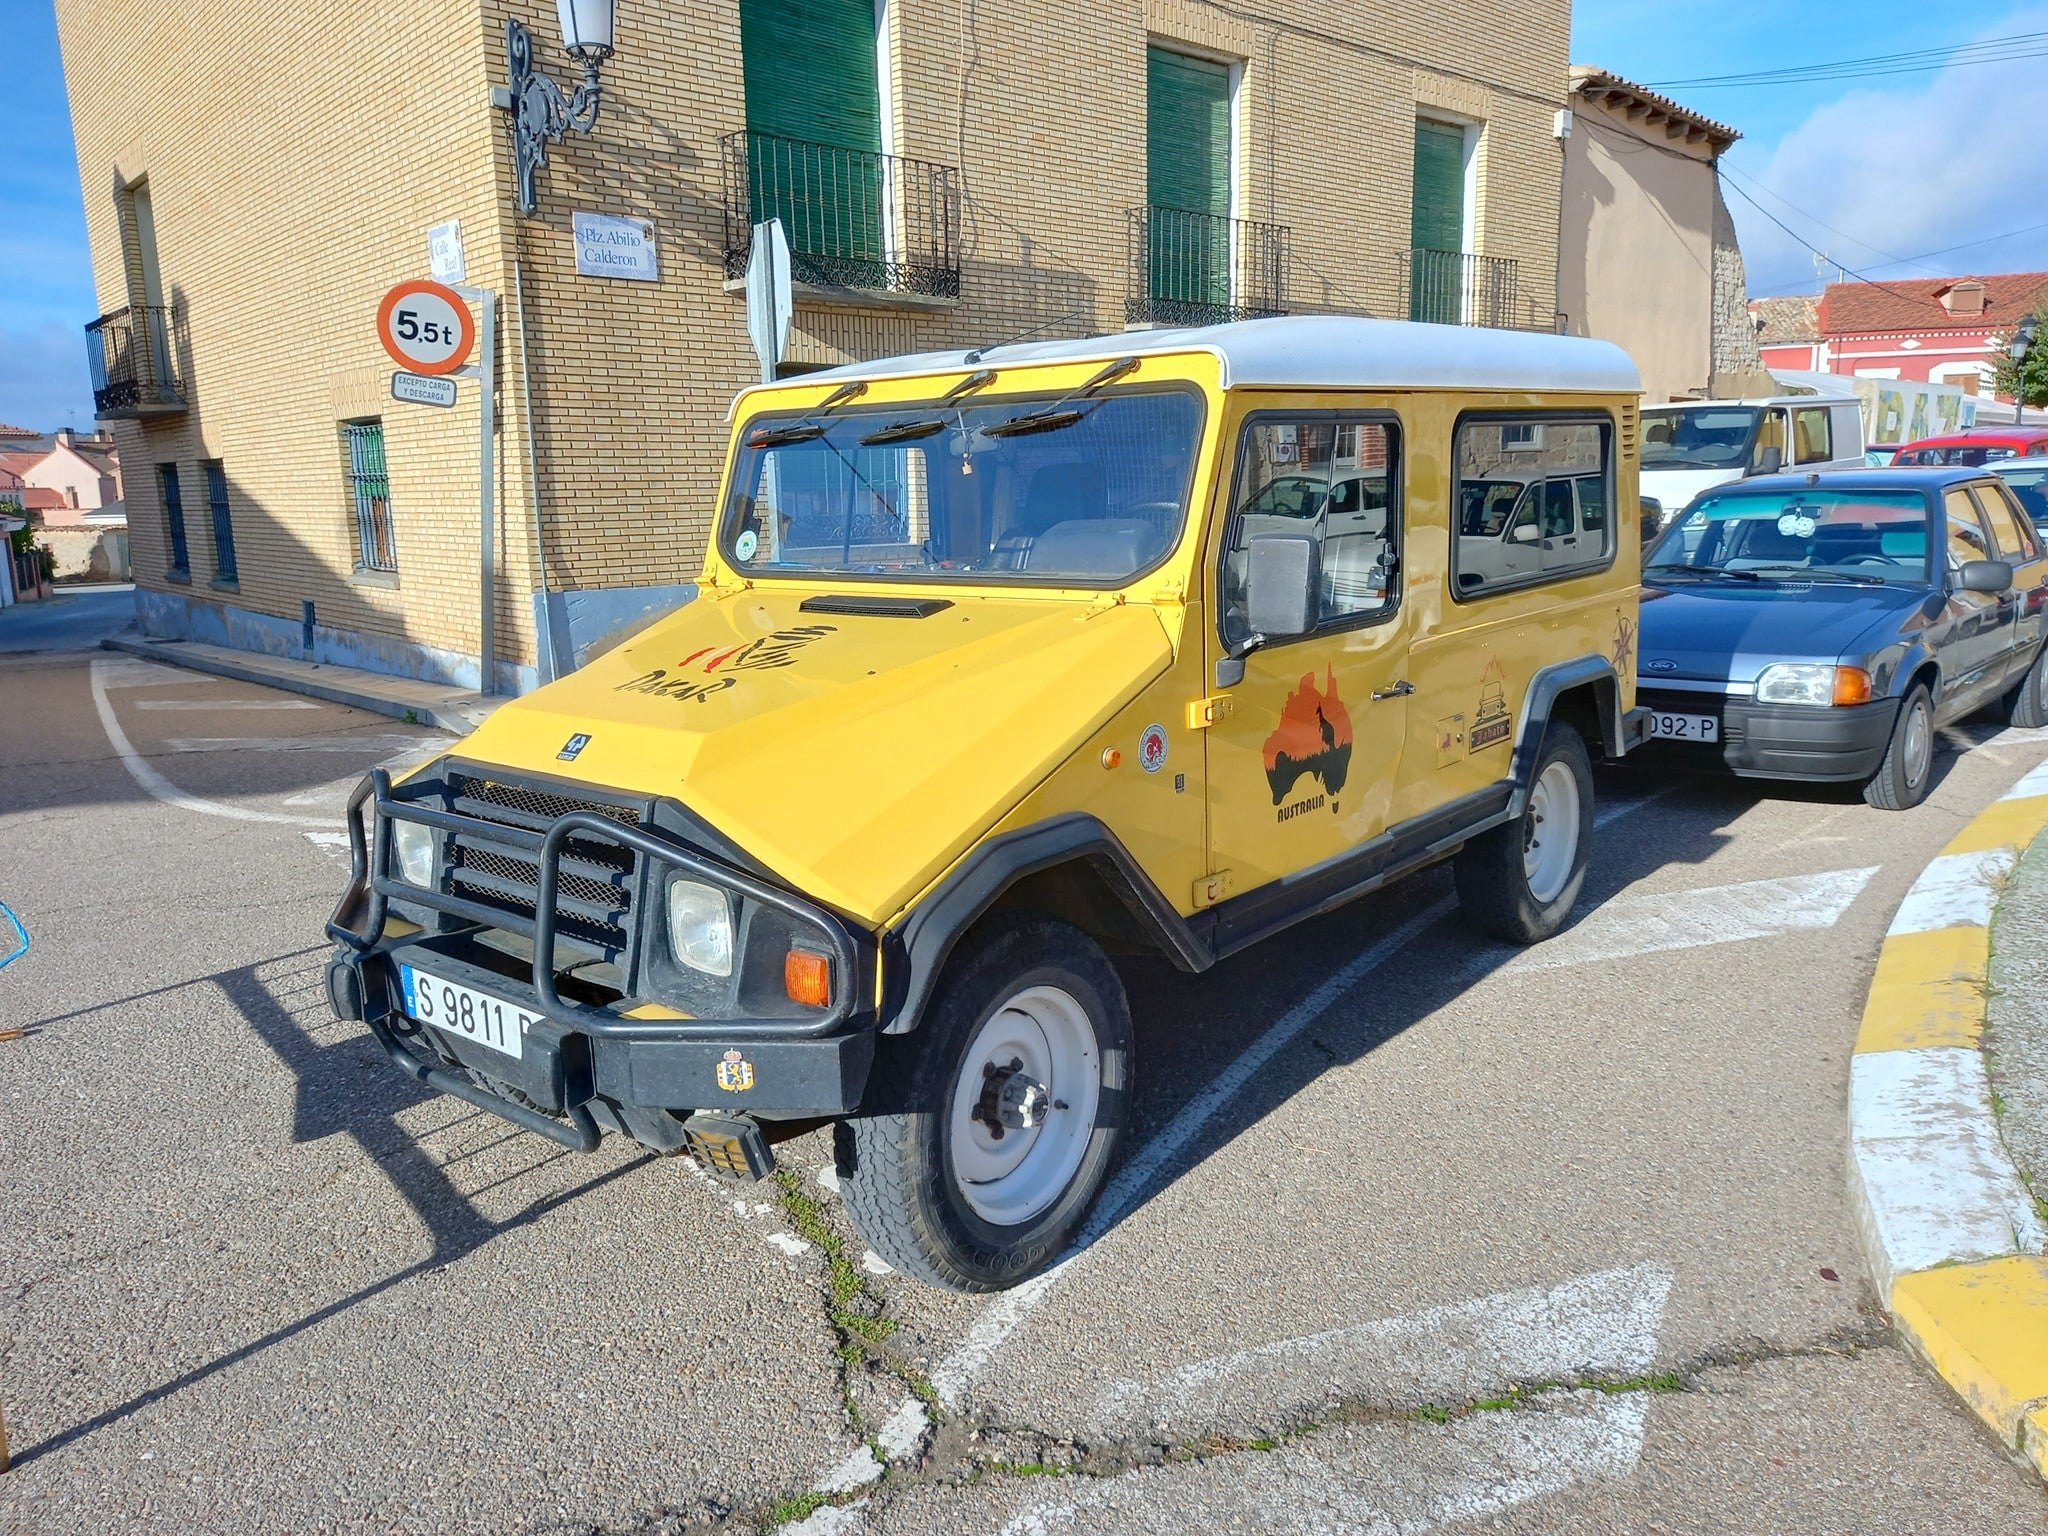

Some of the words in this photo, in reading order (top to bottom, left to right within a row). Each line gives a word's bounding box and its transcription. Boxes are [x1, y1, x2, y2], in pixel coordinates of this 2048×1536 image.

[607, 231, 641, 247] Abilio
[584, 248, 638, 266] Calderon
[398, 376, 428, 388] EXCEPTO
[428, 381, 451, 391] CARGA
[403, 387, 408, 395] Y
[409, 389, 445, 401] DESCARGA
[1277, 793, 1325, 824] AUSTRALIA
[418, 977, 434, 1018] S
[442, 986, 505, 1047] 9811
